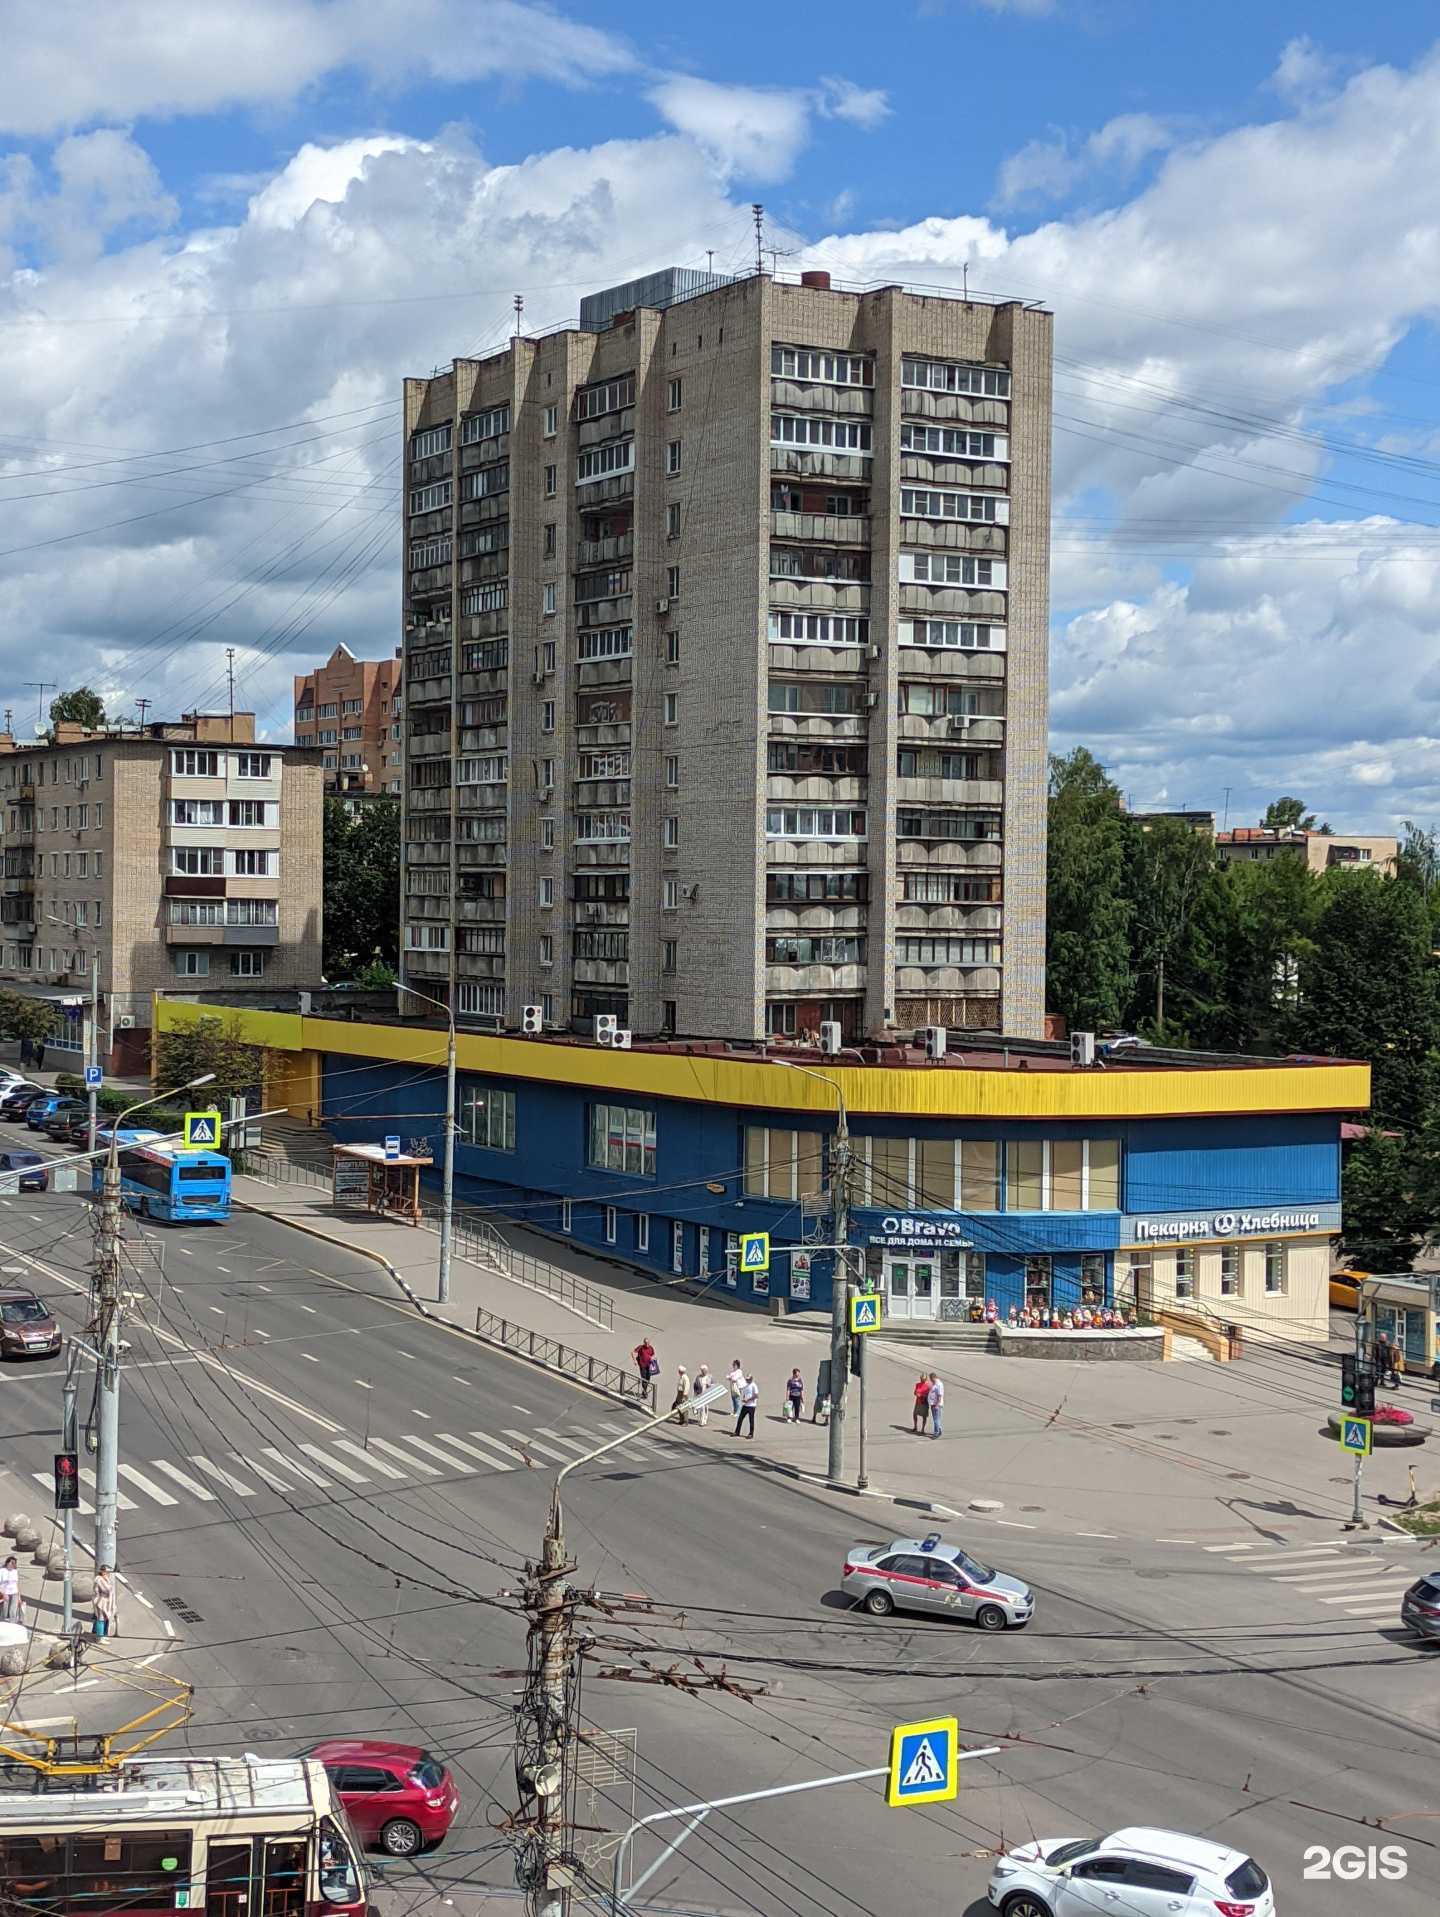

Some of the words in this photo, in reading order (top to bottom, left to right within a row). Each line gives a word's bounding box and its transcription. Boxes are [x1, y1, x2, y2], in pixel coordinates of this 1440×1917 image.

[90, 1069, 98, 1080] P
[901, 1218, 960, 1237] Bravo
[1137, 1221, 1209, 1238] Пекарня
[1241, 1212, 1319, 1231] Хлебница
[887, 1237, 905, 1246] ДЛЯ
[907, 1238, 933, 1247] ДОМА
